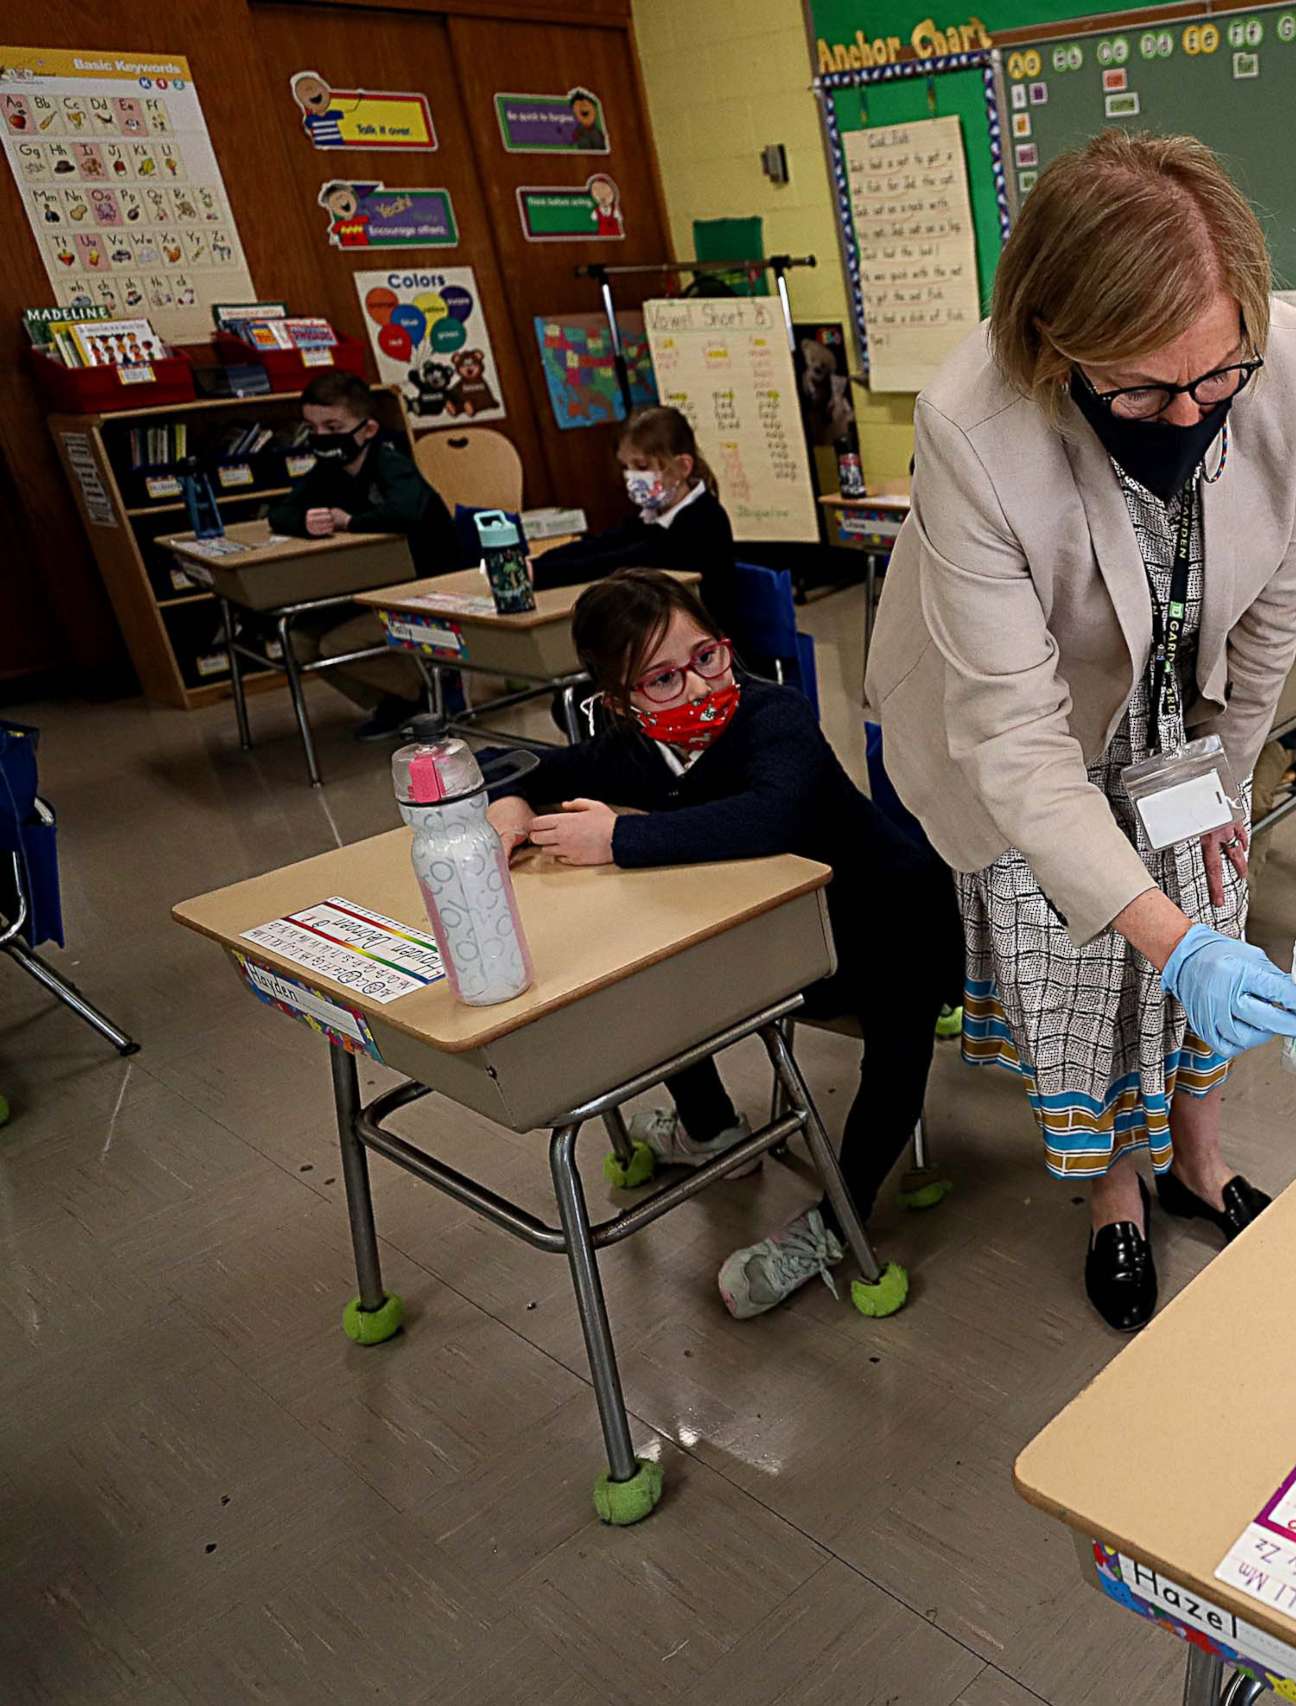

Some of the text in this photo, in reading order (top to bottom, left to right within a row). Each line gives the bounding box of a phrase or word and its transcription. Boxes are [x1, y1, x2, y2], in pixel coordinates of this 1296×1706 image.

[817, 17, 992, 73] Anchor Chart
[73, 57, 182, 75] Basic Keywords
[7, 95, 22, 109] Aa
[35, 97, 51, 110] Bb
[63, 97, 79, 110] Cc
[91, 98, 107, 110] Dd
[356, 123, 378, 137] Talk
[19, 143, 42, 158] Gg
[50, 143, 67, 156] Hh
[33, 190, 57, 202] Mm
[64, 190, 83, 202] Nn
[121, 189, 136, 203] Pp
[368, 225, 417, 238] Encourage
[52, 236, 68, 248] Tt
[387, 273, 446, 289] Colors
[26, 306, 109, 321] MADELINE
[391, 941, 445, 978] Hayden
[248, 967, 299, 1003] Hayden
[1254, 1537, 1281, 1564] Zz
[1238, 1561, 1270, 1592] Mm
[1133, 1561, 1238, 1640] Hazel
